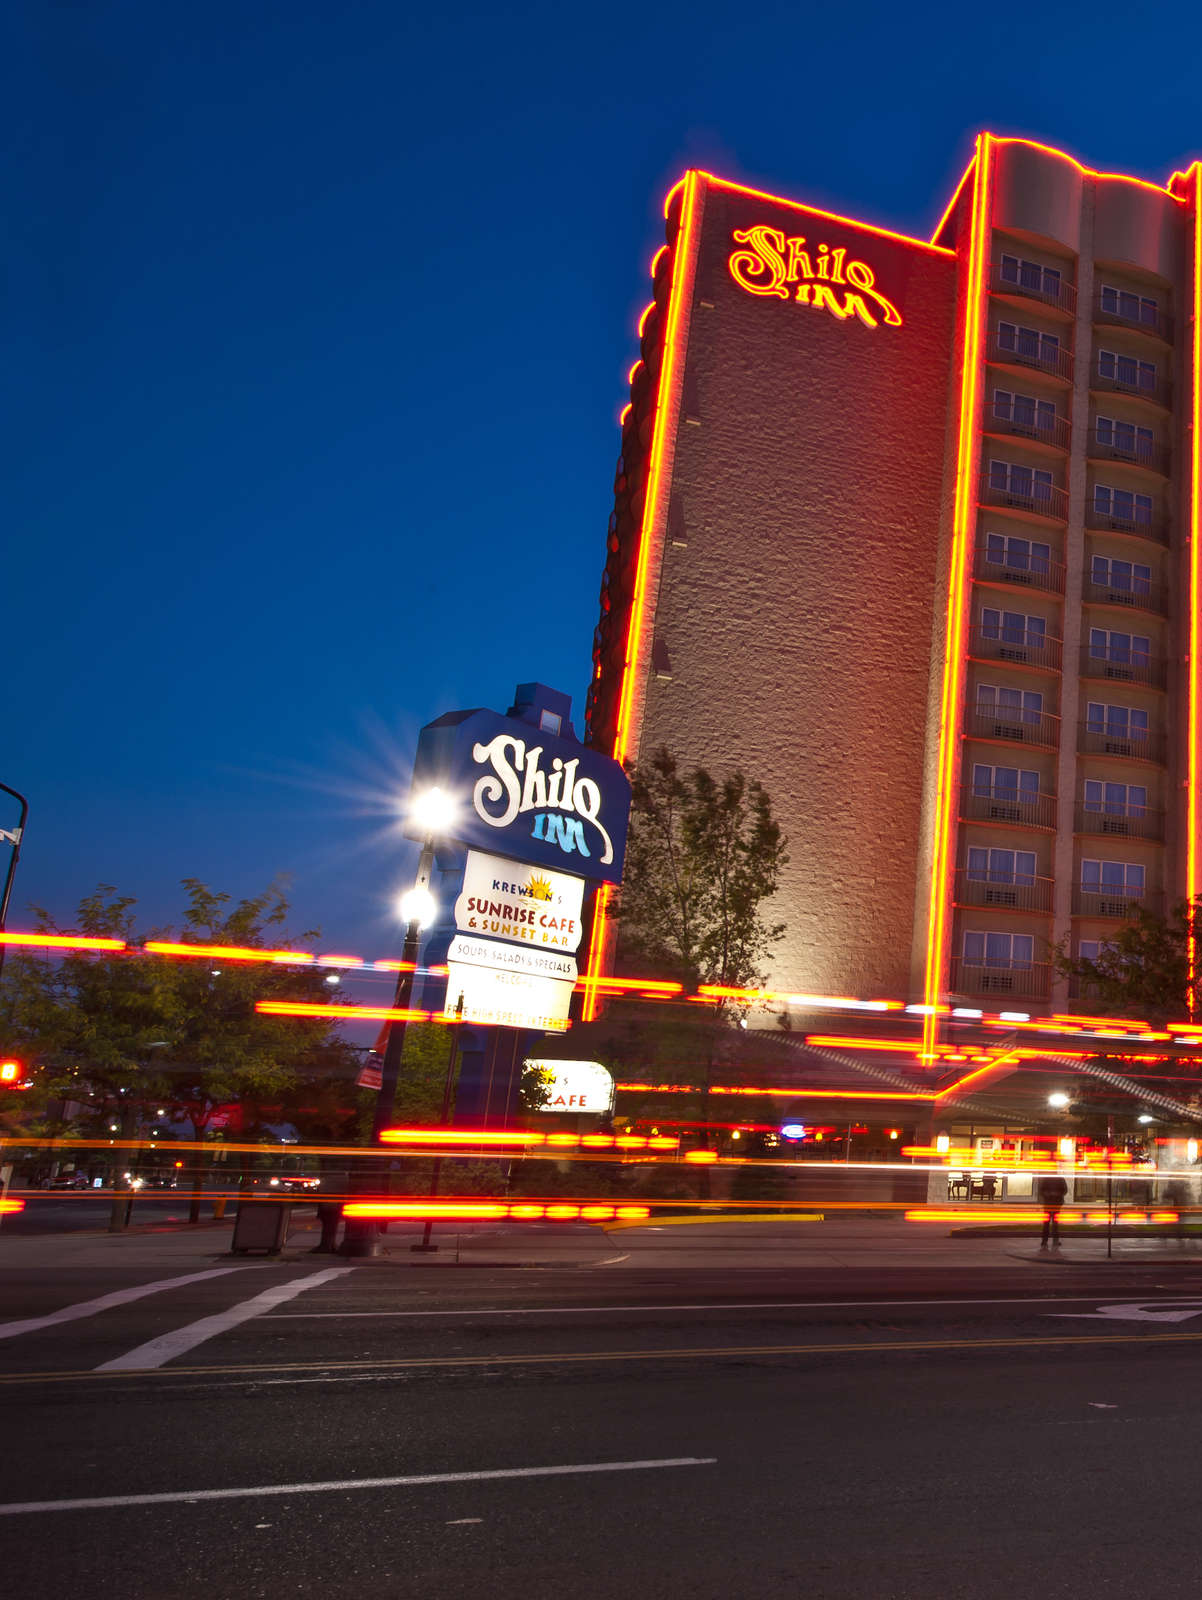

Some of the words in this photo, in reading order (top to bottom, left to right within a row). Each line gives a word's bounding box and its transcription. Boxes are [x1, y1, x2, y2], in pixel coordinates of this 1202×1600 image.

[729, 225, 902, 326] Shilo
[795, 284, 878, 329] INN
[472, 734, 613, 864] Shilo
[530, 812, 591, 858] INN
[467, 897, 536, 925] SUNRISE
[539, 914, 575, 934] CAFE
[468, 917, 477, 928] &
[482, 919, 537, 940] SUNSET
[542, 932, 568, 946] BAR
[535, 958, 571, 973] SPECIALS
